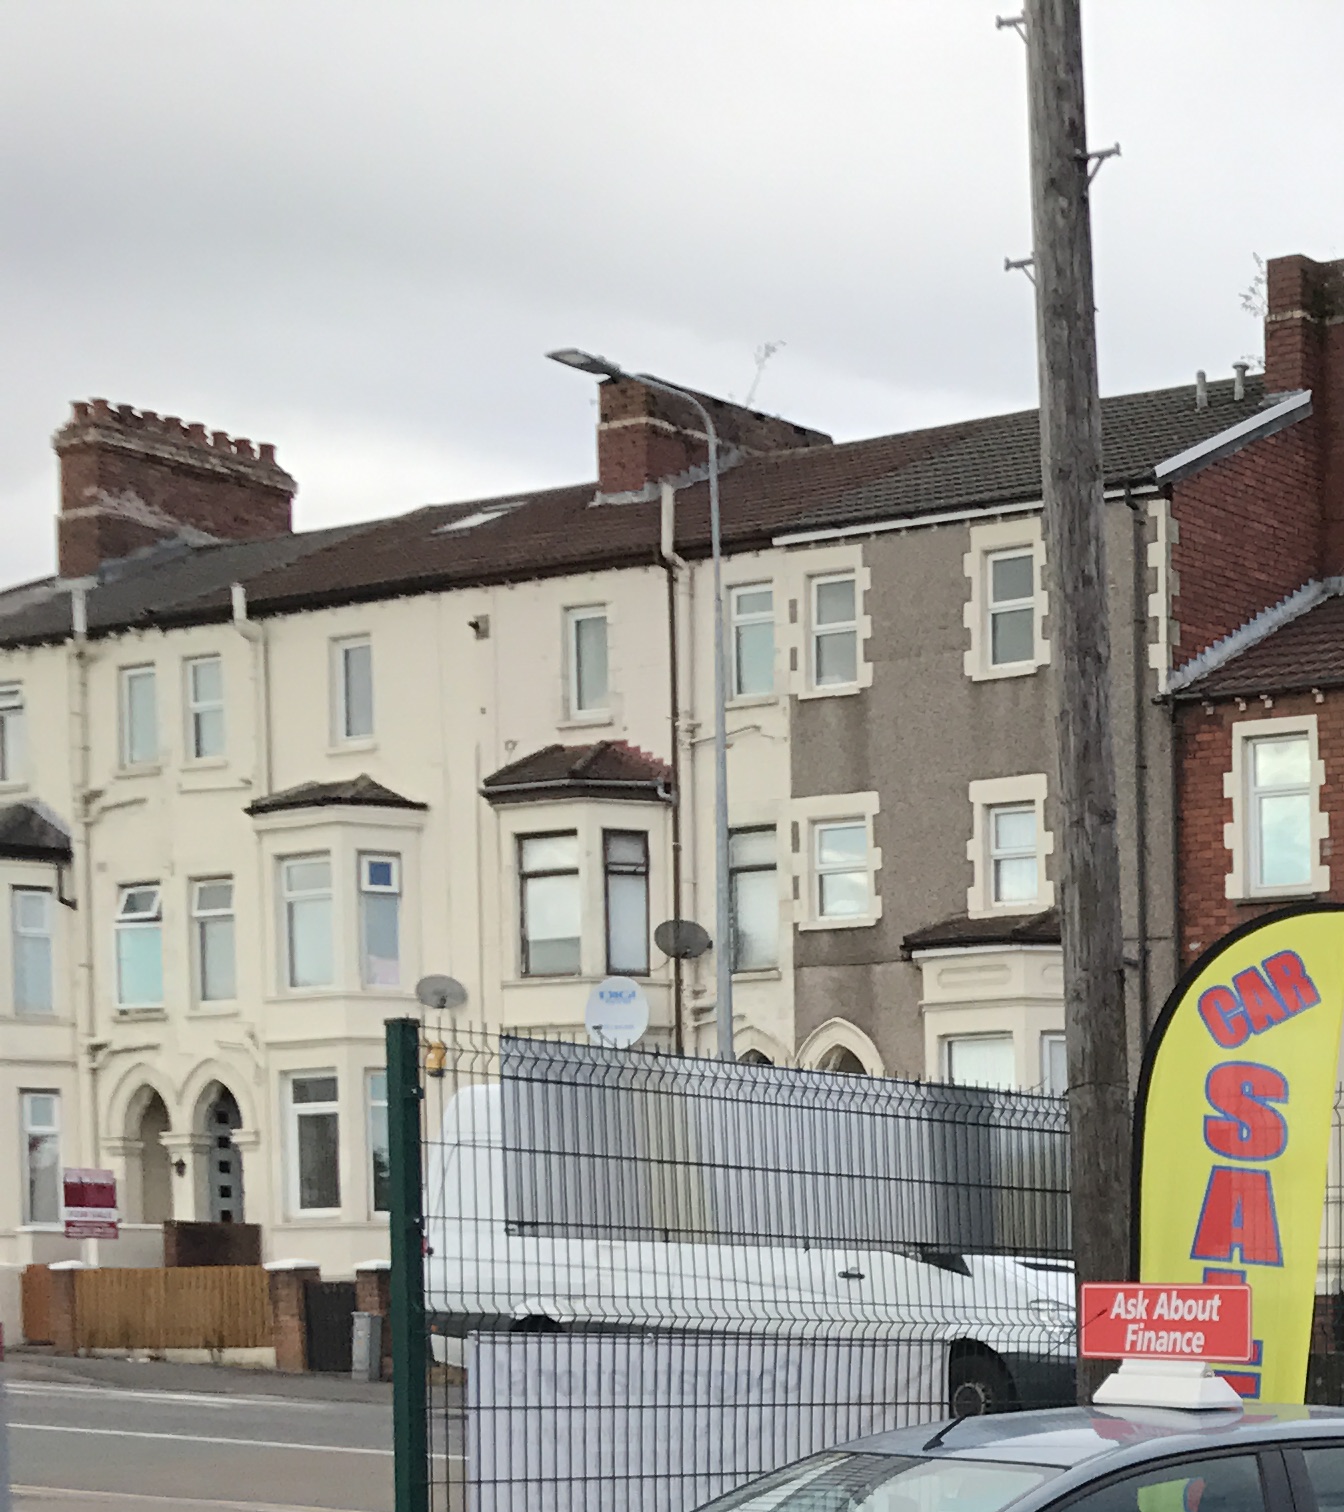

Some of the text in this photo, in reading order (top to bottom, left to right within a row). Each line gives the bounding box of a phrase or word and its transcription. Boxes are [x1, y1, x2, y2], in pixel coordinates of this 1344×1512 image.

[1198, 950, 1322, 1049] CAR
[1190, 1061, 1289, 1399] SA
[1110, 1291, 1221, 1323] Ask About
[1124, 1323, 1205, 1355] Finance
